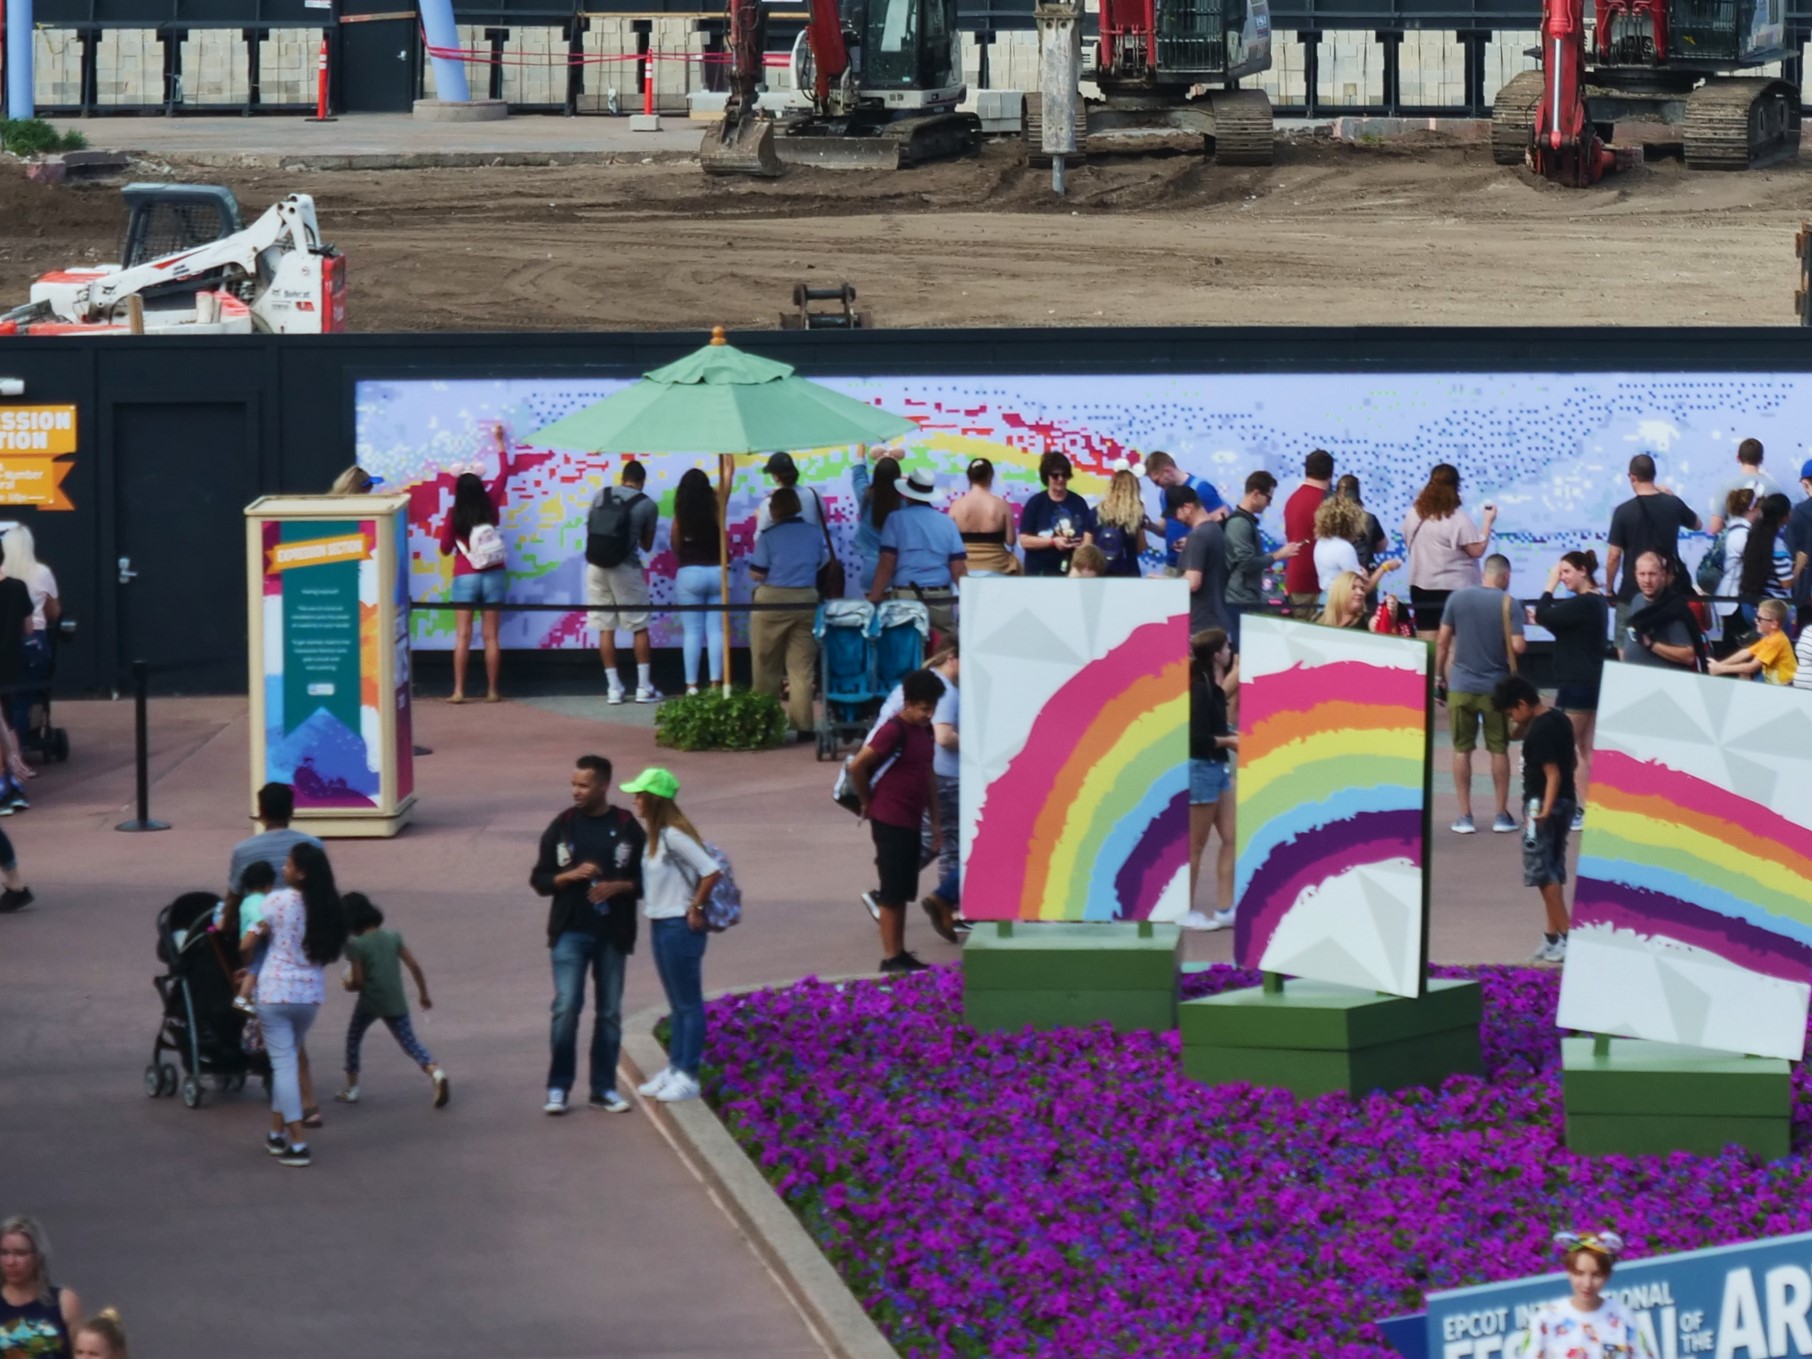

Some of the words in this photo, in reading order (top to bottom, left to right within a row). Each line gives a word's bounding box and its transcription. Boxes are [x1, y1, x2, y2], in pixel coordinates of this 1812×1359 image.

[1442, 1307, 1509, 1341] EPCOT
[1680, 1310, 1705, 1333] OF
[1680, 1329, 1715, 1354] THE
